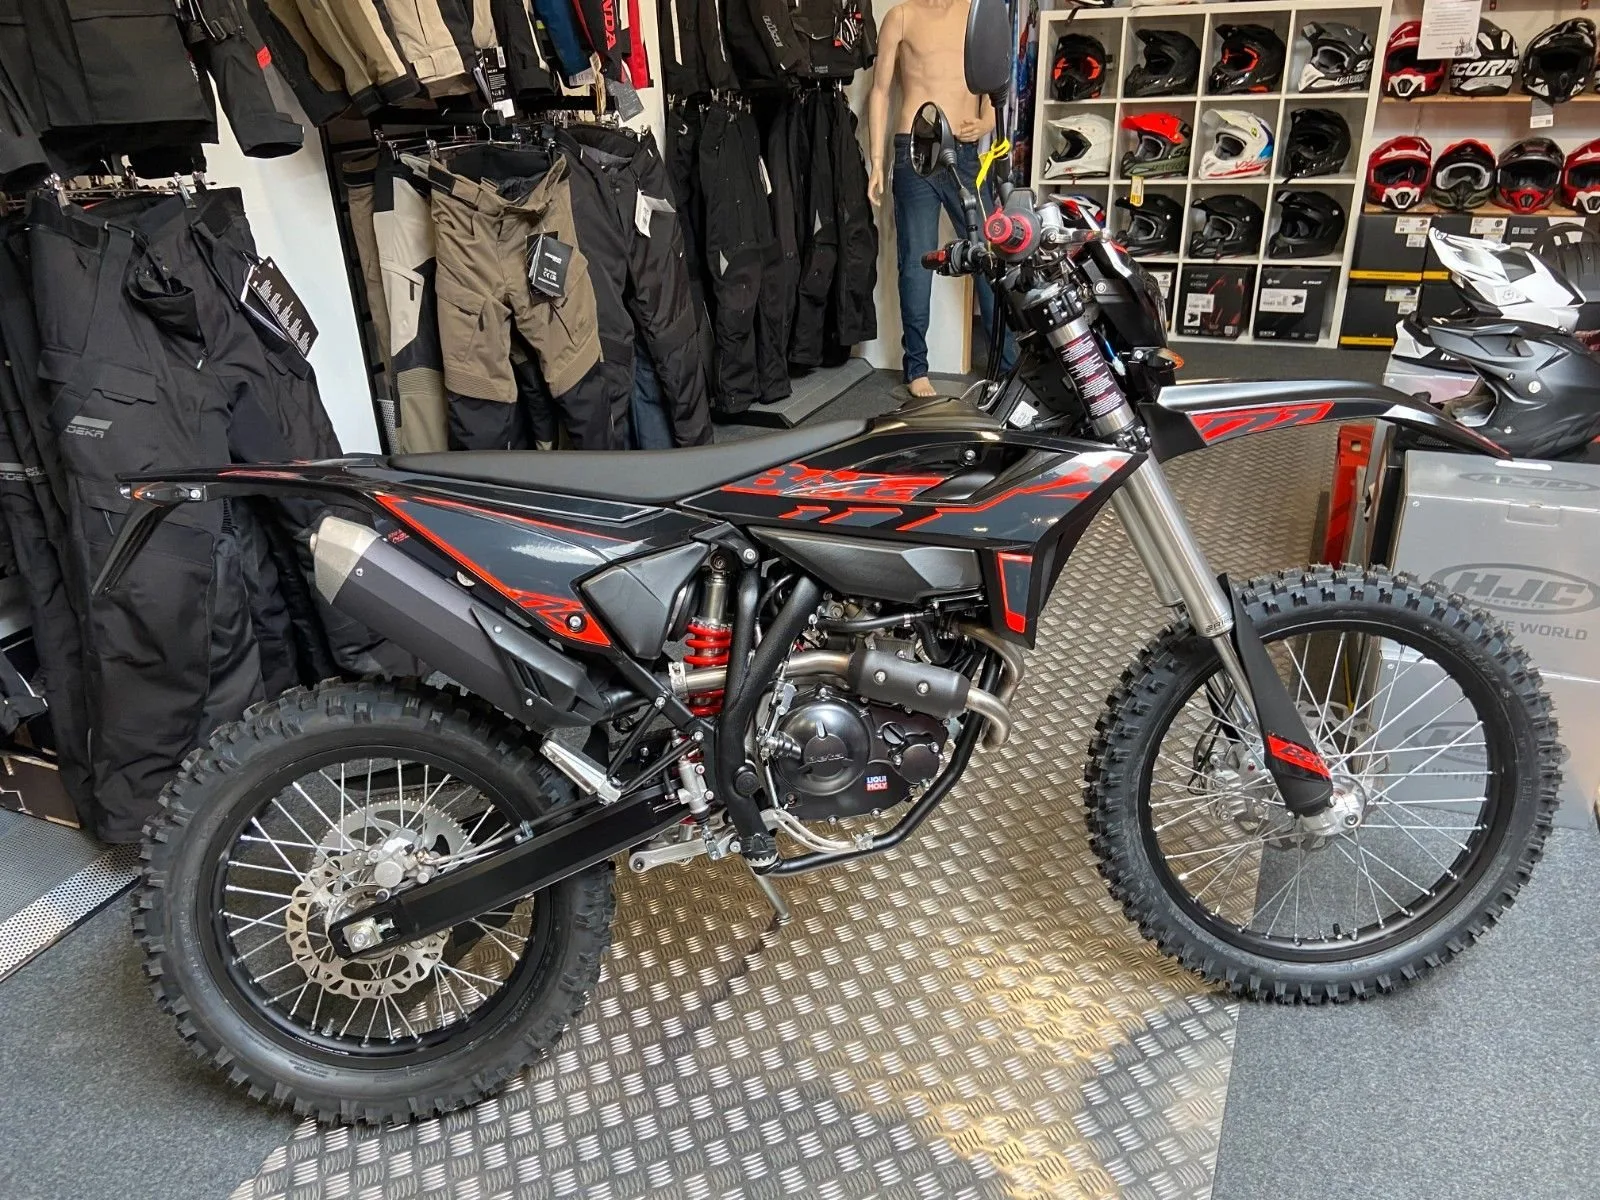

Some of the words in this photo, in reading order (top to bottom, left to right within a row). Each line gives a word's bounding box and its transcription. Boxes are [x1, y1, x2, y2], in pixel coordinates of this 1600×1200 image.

[64, 425, 105, 439] DEKA
[1452, 571, 1588, 606] HJC
[1519, 622, 1588, 641] WORLD
[866, 781, 888, 792] MOLY
[867, 775, 887, 784] LIQUI
